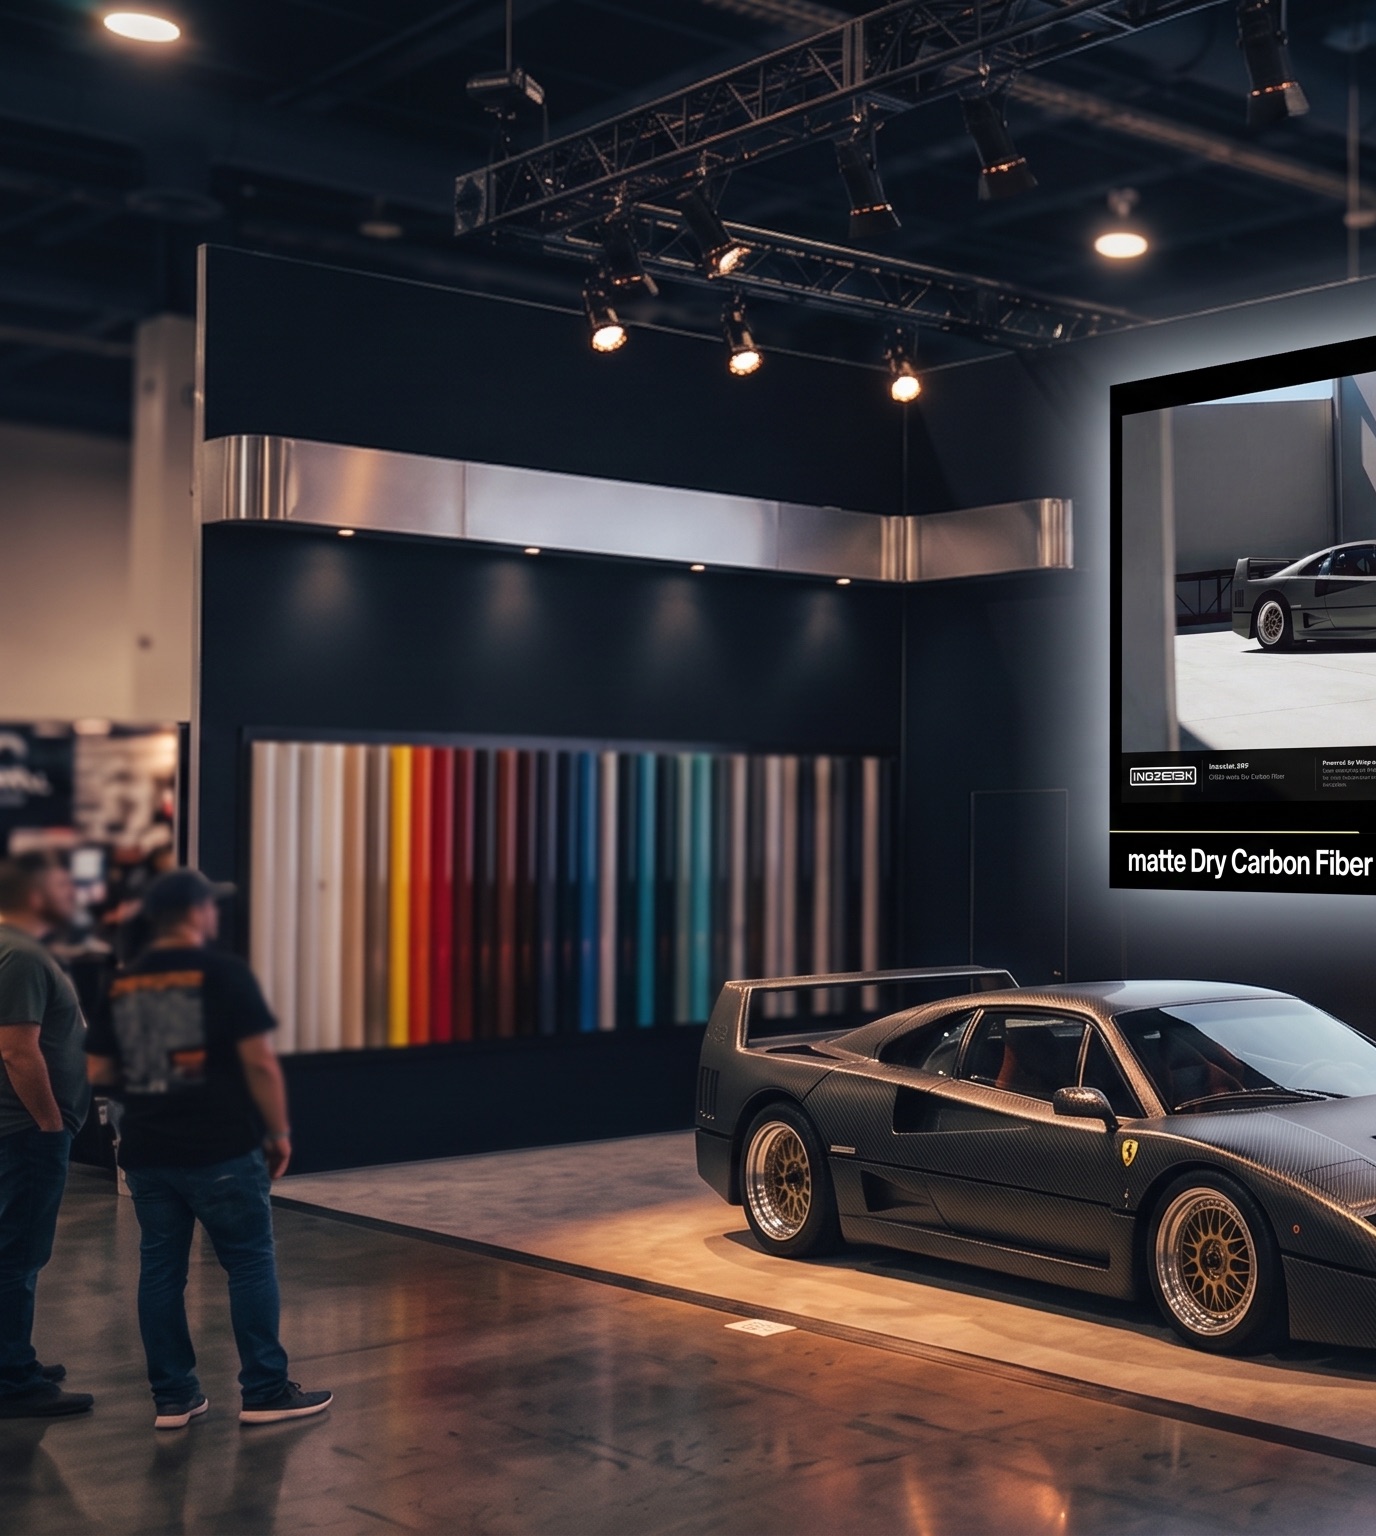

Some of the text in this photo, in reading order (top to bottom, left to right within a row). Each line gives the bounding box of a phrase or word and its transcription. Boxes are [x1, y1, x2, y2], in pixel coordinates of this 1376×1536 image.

[1129, 848, 1373, 879] matte Dry Carbon Fiber
